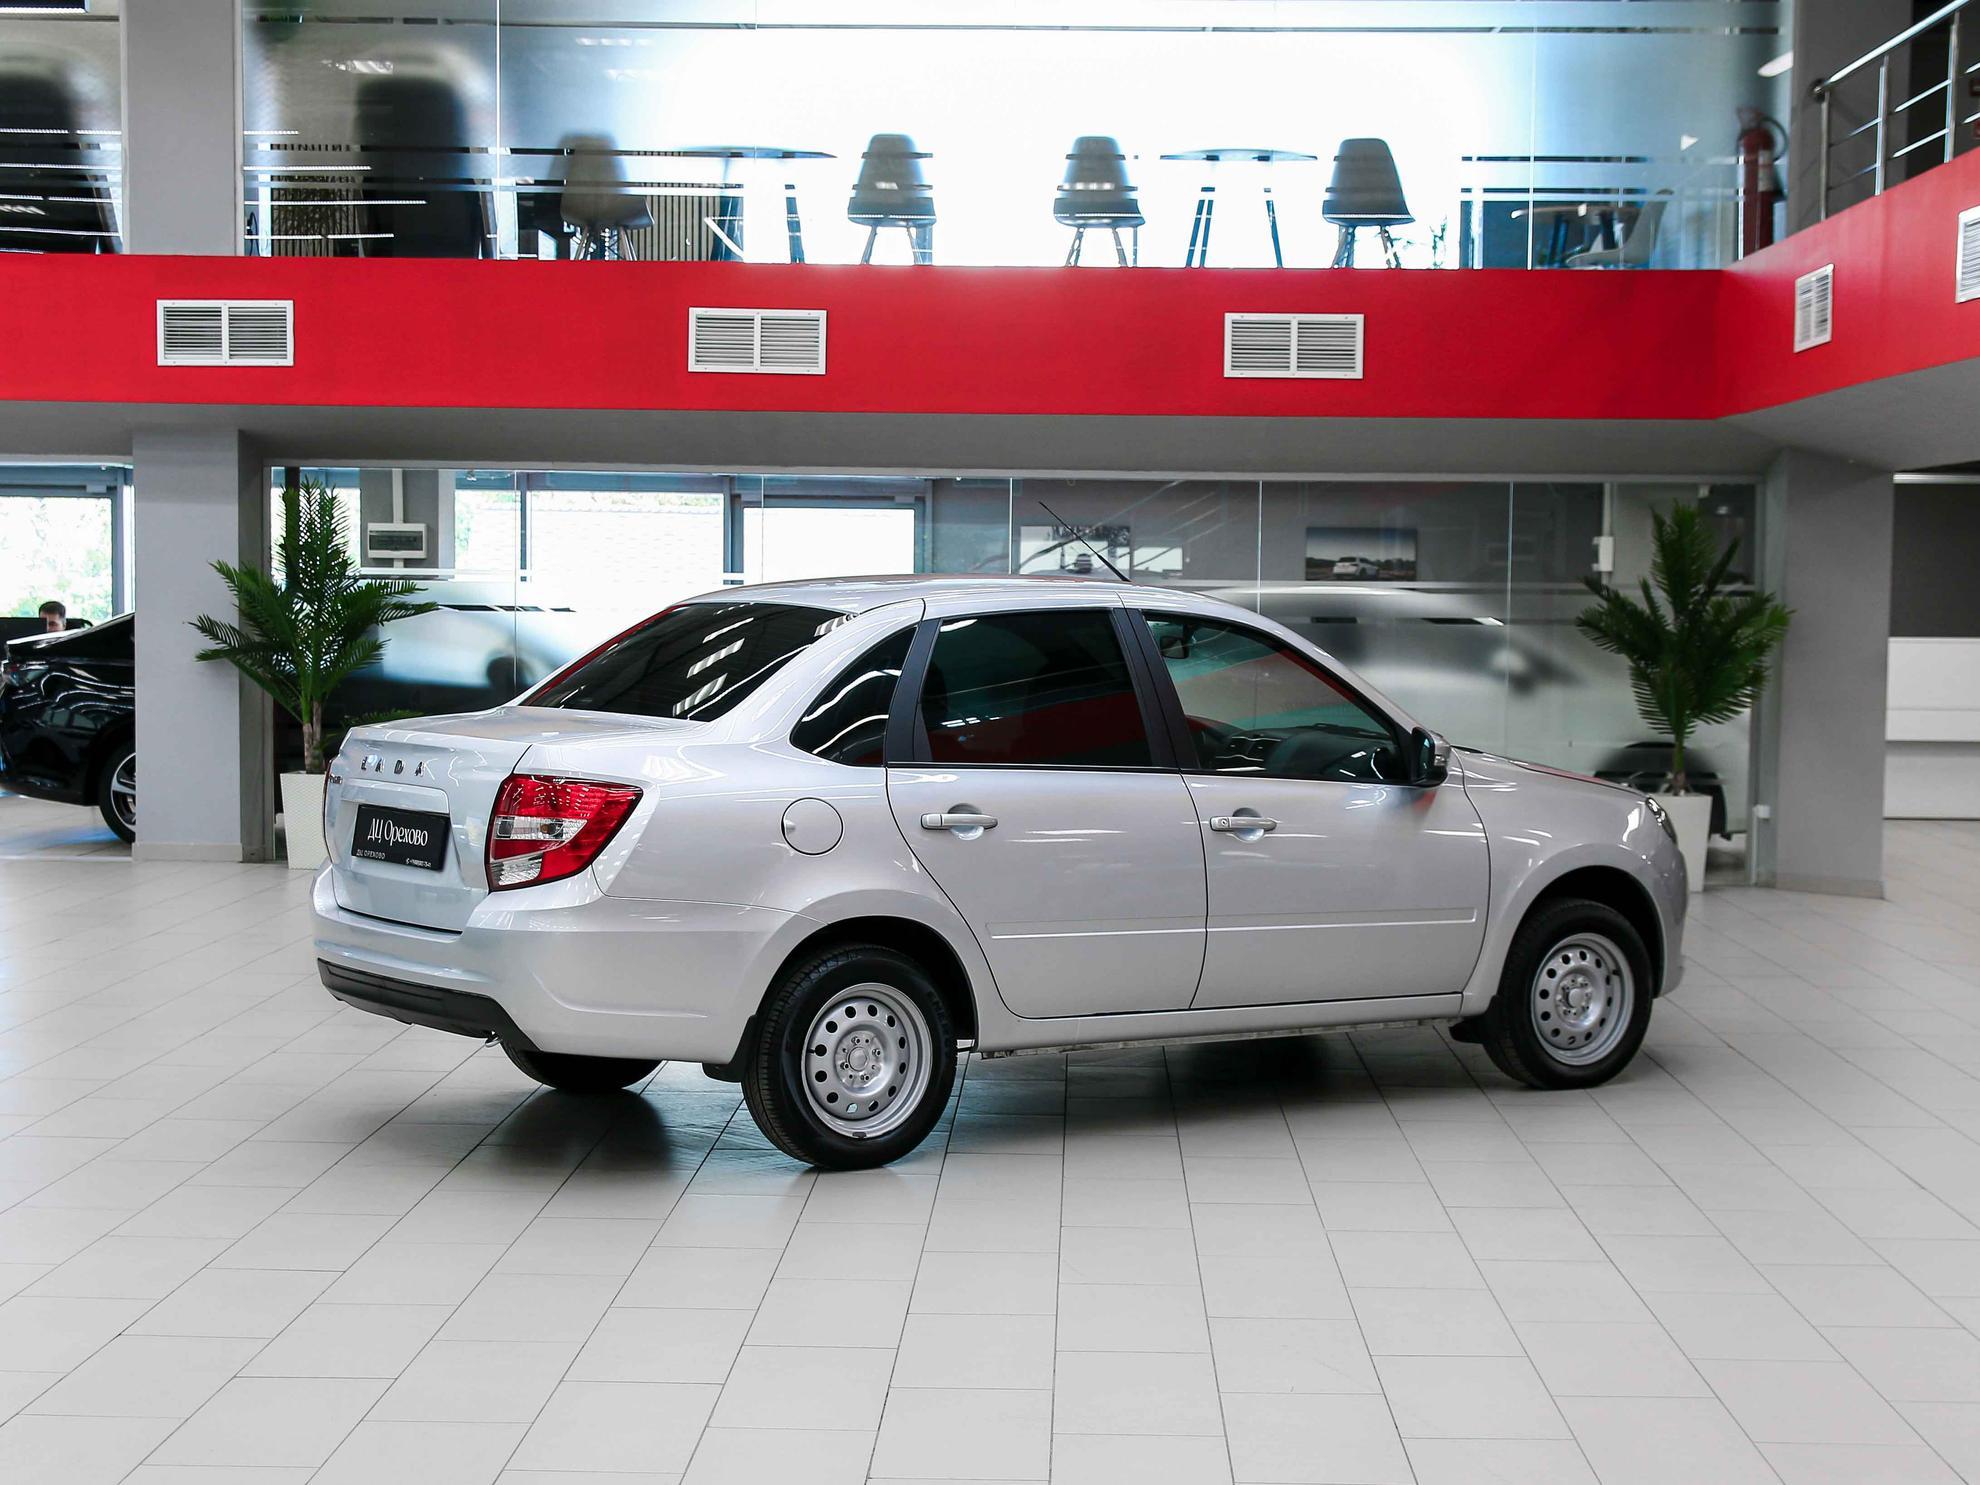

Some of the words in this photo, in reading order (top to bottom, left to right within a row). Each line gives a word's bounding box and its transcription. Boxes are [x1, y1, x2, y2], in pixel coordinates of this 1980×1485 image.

[361, 756, 424, 777] LADA
[367, 818, 384, 844] ДЦ
[384, 820, 429, 847] Орехово
